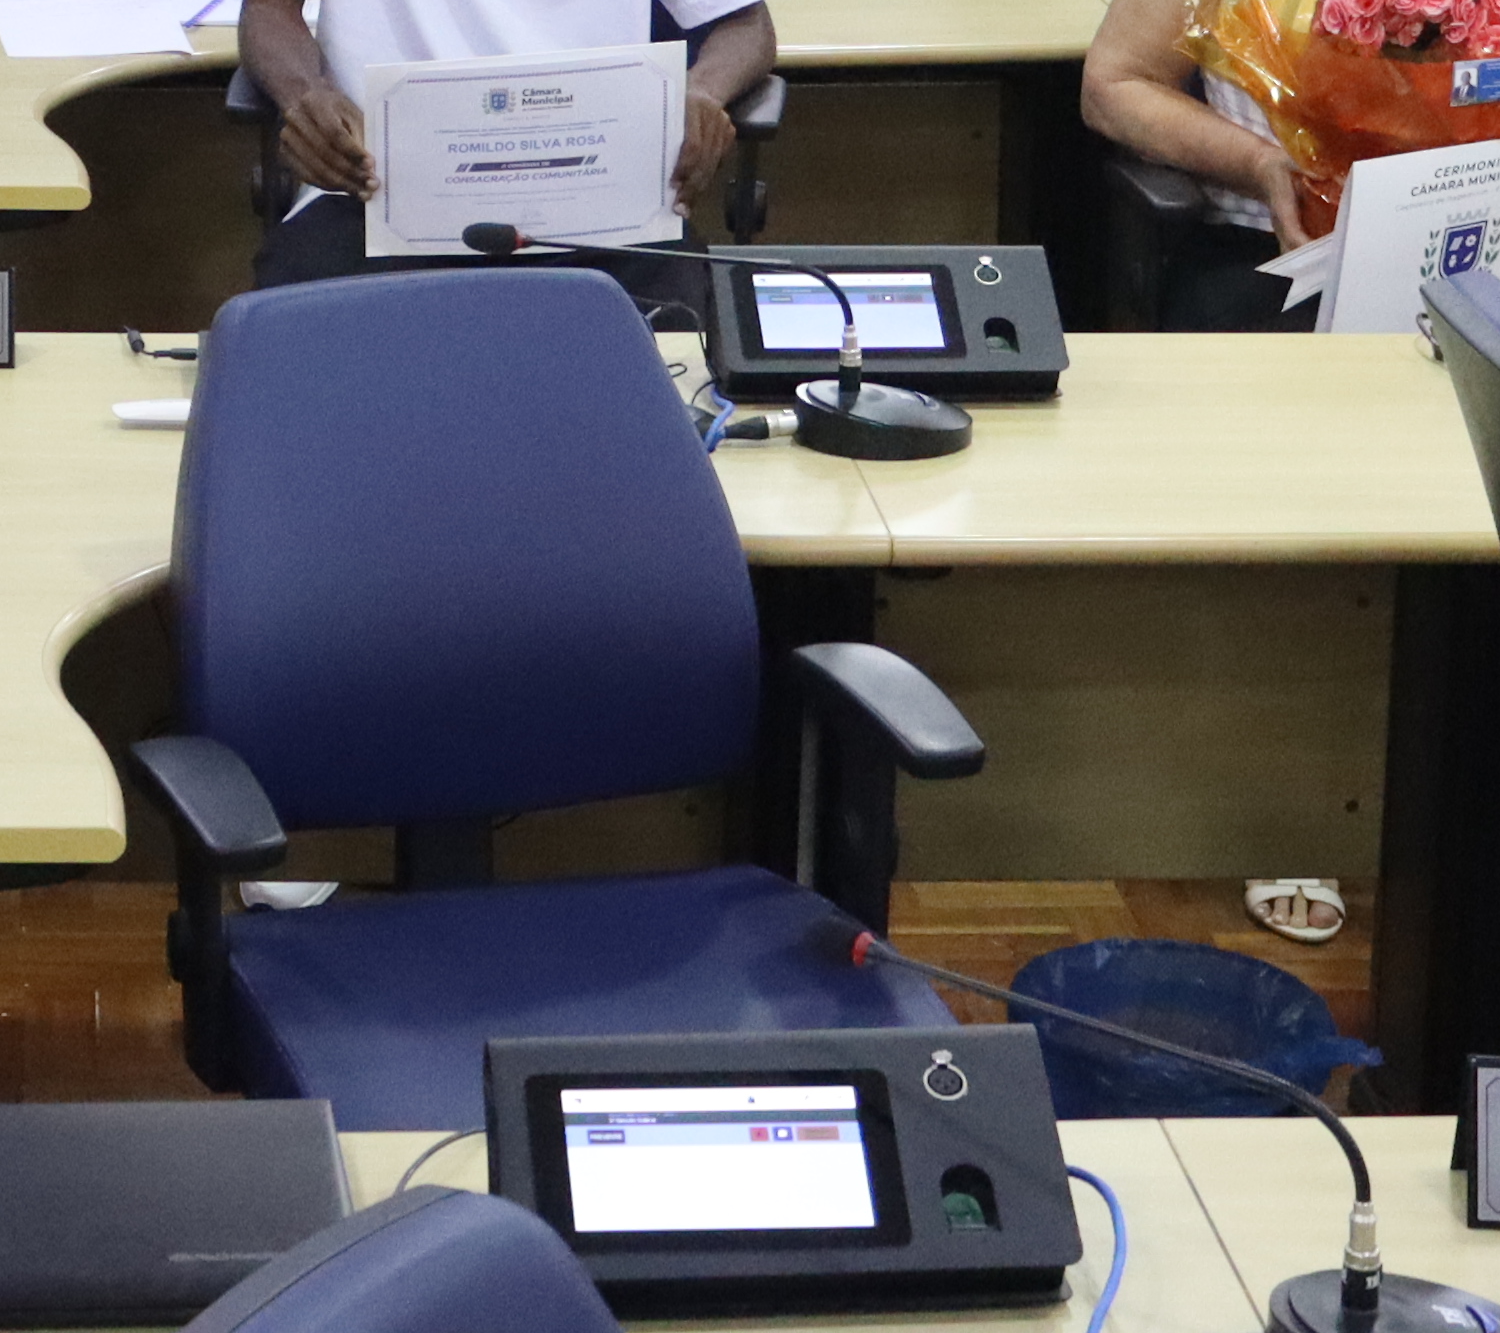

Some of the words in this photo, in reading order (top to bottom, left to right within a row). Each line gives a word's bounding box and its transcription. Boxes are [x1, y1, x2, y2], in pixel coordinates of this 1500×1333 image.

[522, 88, 561, 97] Câmara
[522, 95, 573, 106] Municipal
[448, 141, 515, 154] ROMILDO
[520, 139, 561, 150] SILVA
[566, 135, 606, 147] ROSA
[1411, 178, 1464, 197] CÂMARA
